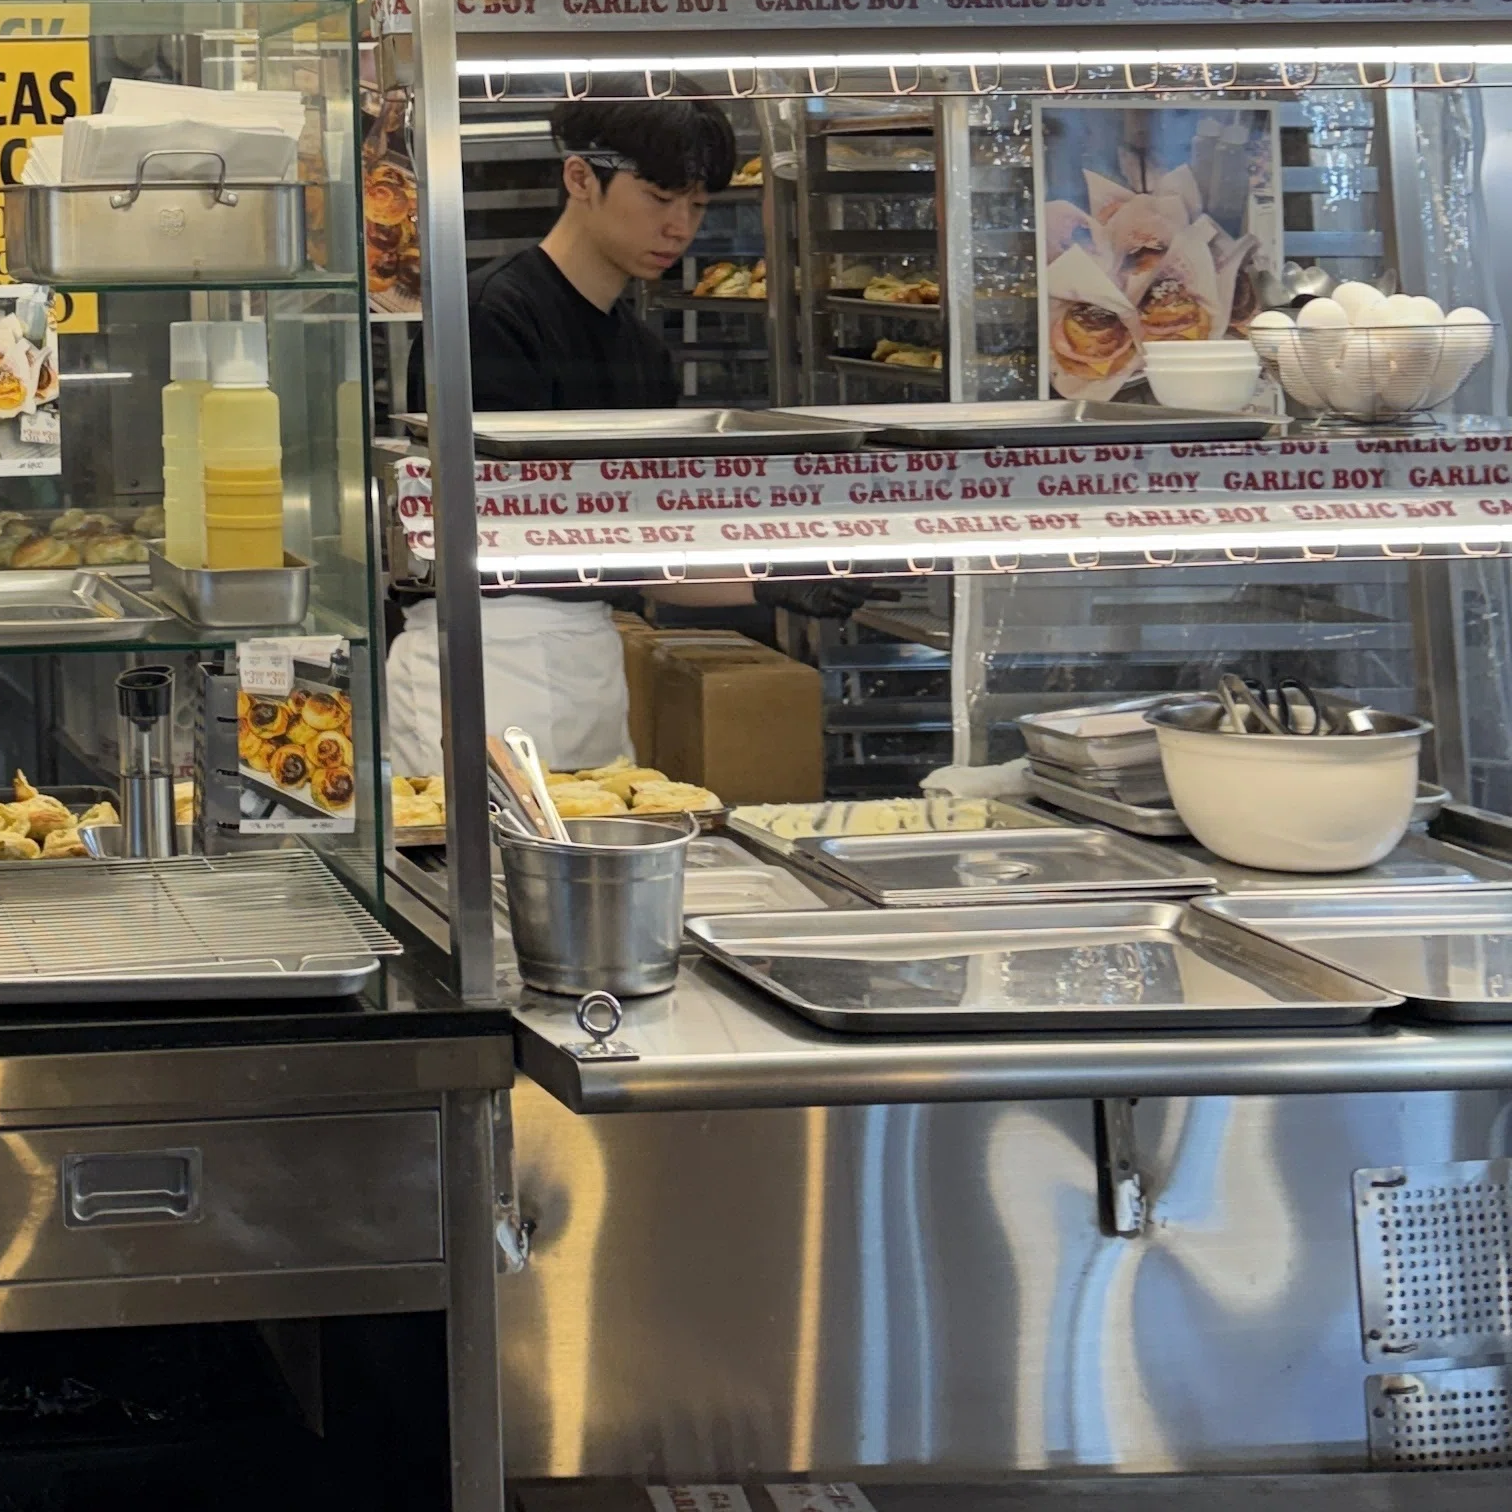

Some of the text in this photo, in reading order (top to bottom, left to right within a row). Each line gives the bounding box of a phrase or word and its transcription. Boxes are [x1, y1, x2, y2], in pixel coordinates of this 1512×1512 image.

[520, 461, 575, 482] BOY
[601, 459, 706, 480] GARLIC
[714, 457, 769, 478] BOY
[794, 453, 897, 476] GARLIC
[906, 451, 960, 472] BOY
[984, 448, 1086, 469] GARLIC
[1094, 445, 1144, 462] BOY
[576, 491, 632, 514] BOY
[656, 486, 762, 511] GARLIC
[770, 484, 825, 507] BOY
[848, 480, 953, 504] GARLIC
[960, 476, 1015, 500] BOY
[1038, 472, 1139, 496] GARLIC
[1147, 471, 1201, 493] BOY
[1223, 469, 1325, 491] GARLIC
[1333, 467, 1386, 489] BOY
[1408, 464, 1511, 487] GARLIC
[525, 527, 634, 547] GARLIC
[638, 525, 696, 544] BOY
[721, 520, 828, 541] GARLIC
[833, 518, 891, 537] BOY
[915, 515, 1020, 535] GARLIC
[1026, 512, 1082, 530] BOY
[1105, 507, 1210, 528] GARLIC
[1213, 505, 1270, 523] BOY
[1292, 502, 1398, 521] GARLIC
